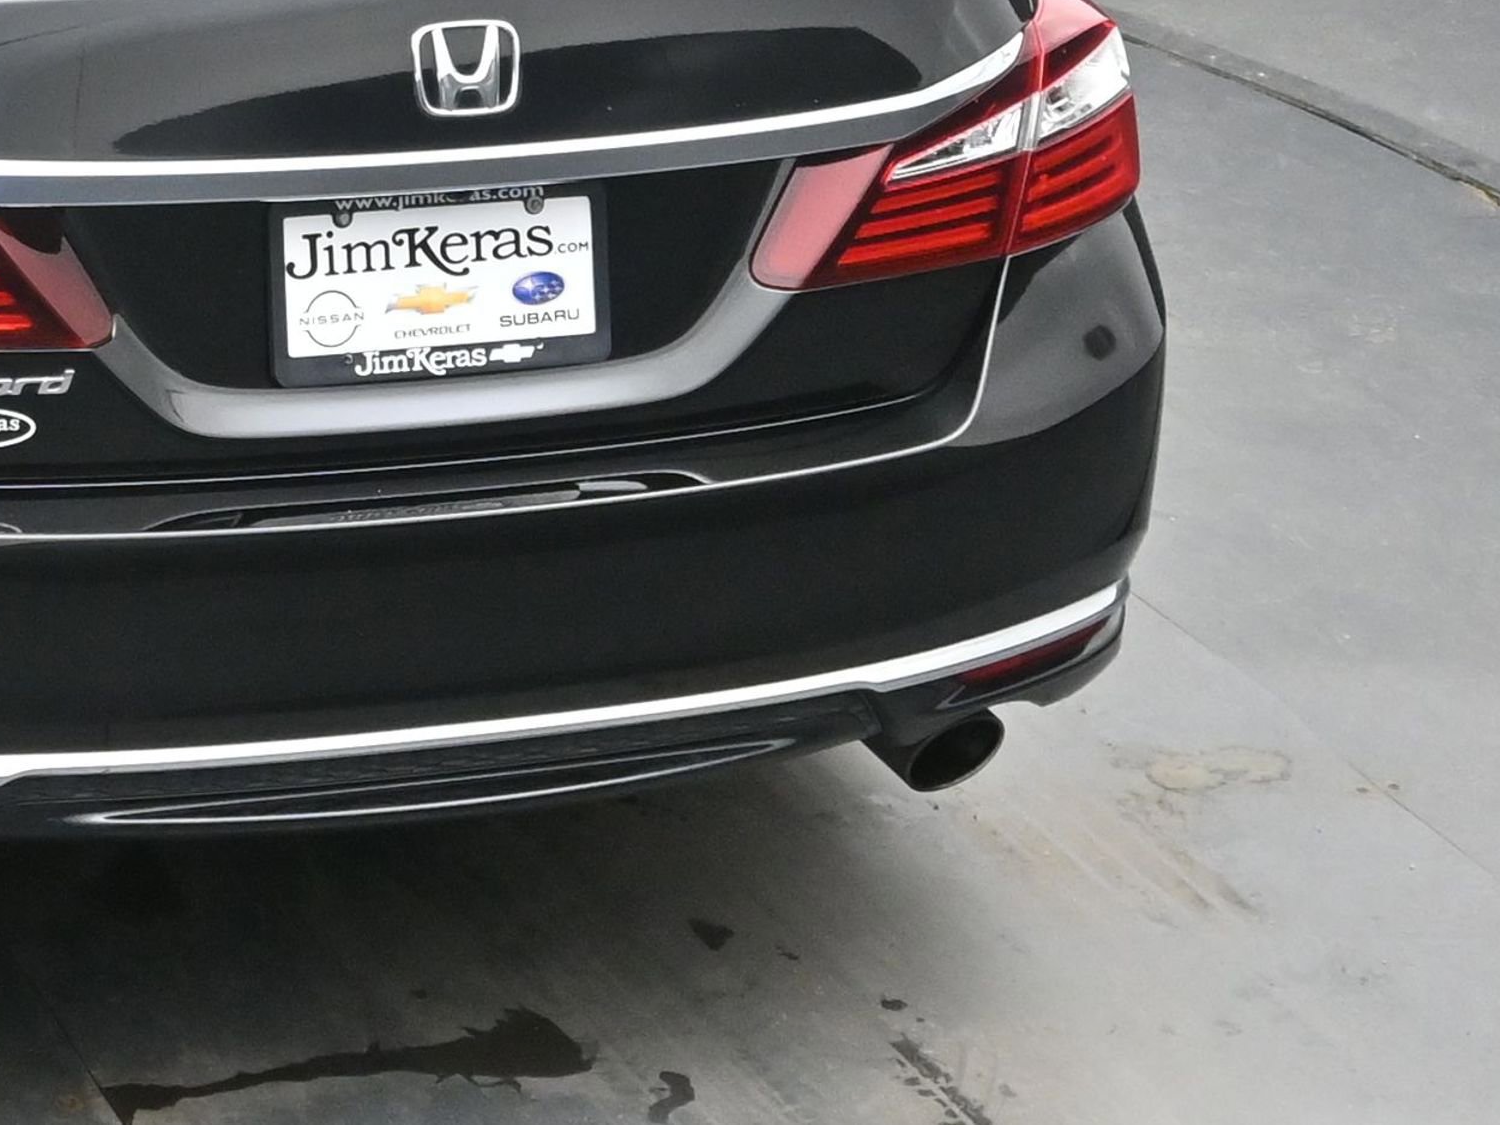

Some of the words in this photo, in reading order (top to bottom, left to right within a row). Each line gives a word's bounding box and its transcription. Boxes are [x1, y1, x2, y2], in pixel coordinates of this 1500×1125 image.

[299, 312, 365, 326] NISSAN
[500, 308, 580, 328] SUBARU
[394, 323, 472, 340] CHEVROLET
